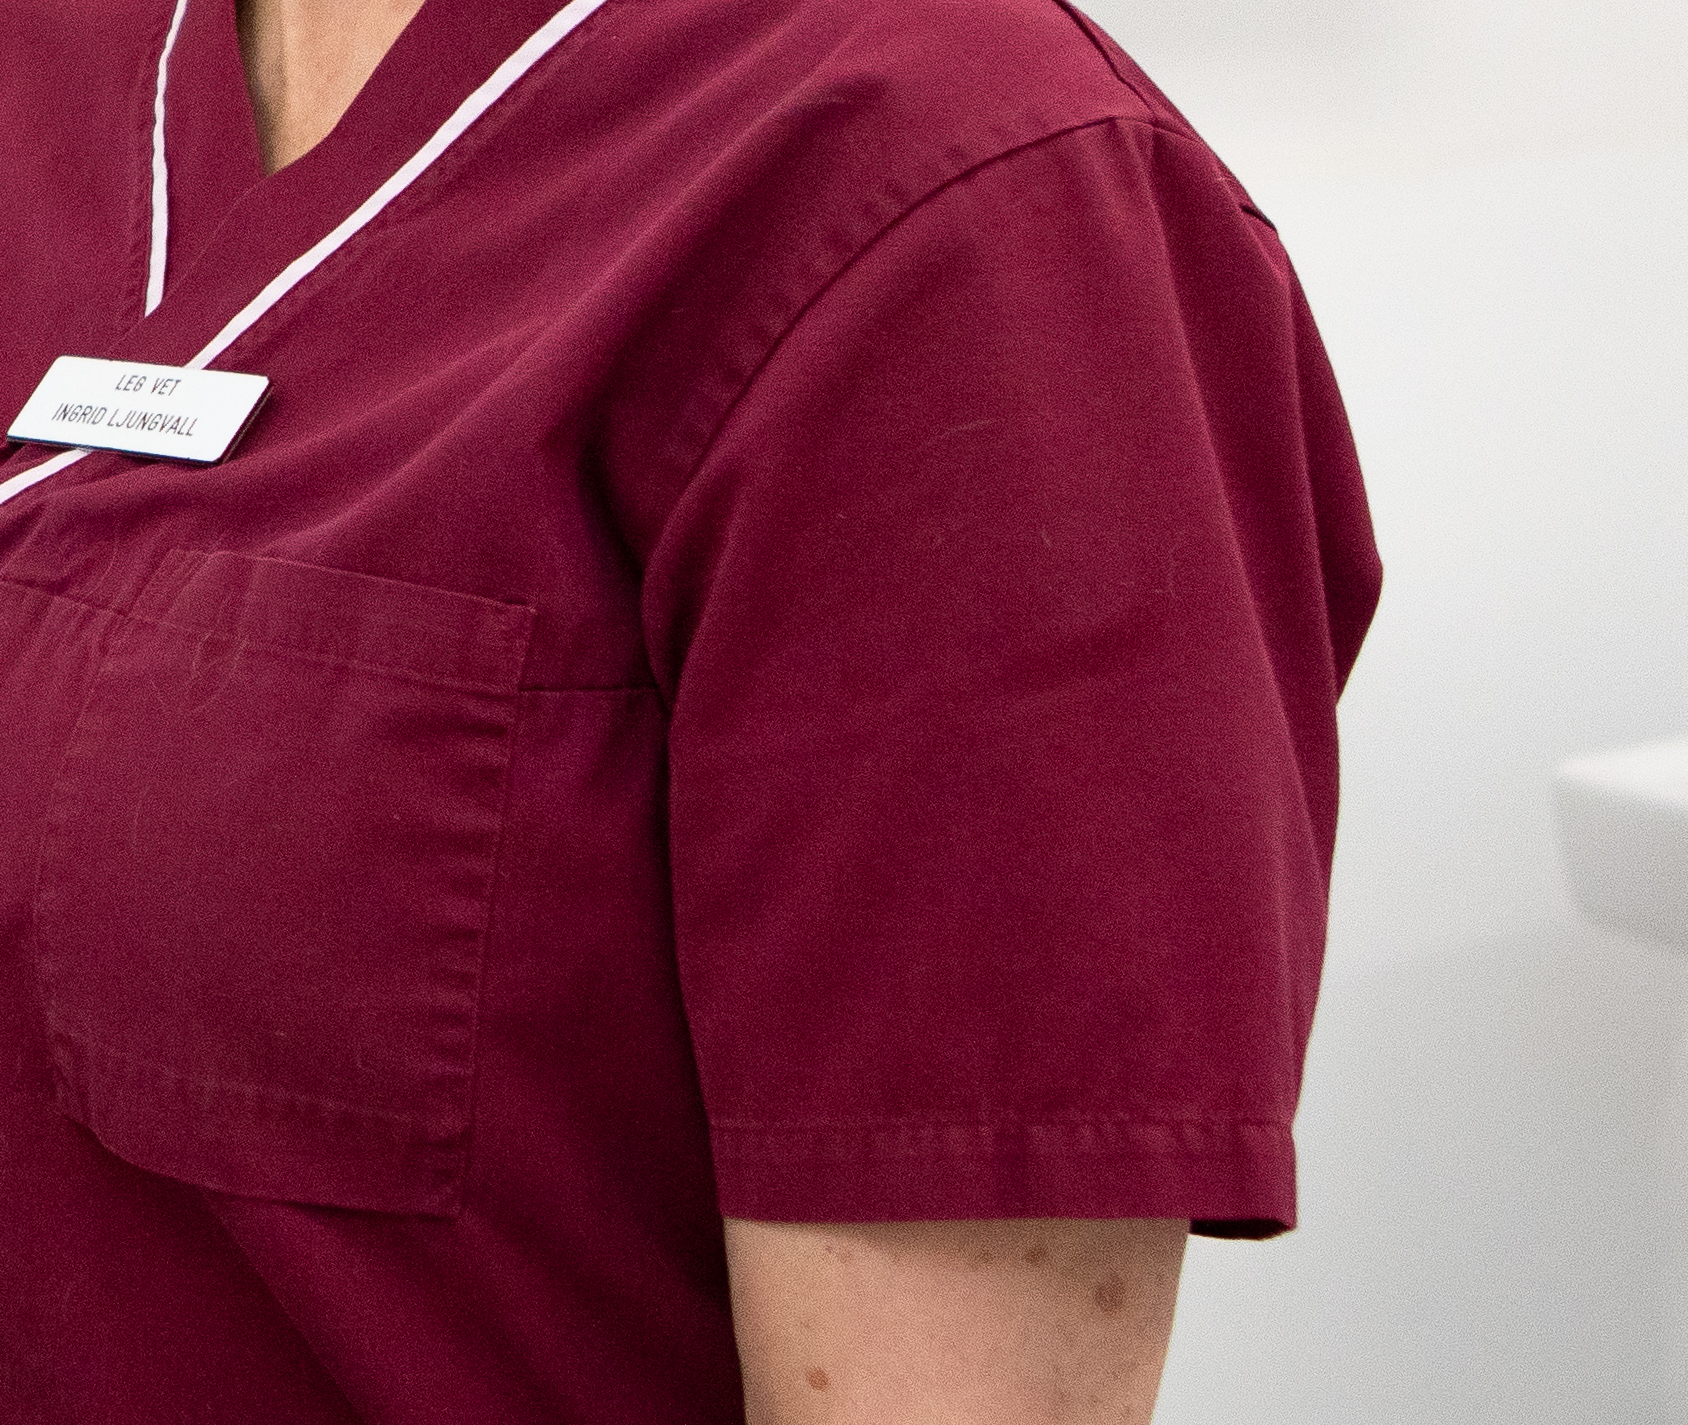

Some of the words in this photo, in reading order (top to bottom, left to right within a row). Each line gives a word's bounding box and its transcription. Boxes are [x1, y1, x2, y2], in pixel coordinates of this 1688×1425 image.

[114, 374, 147, 393] LEG
[151, 378, 182, 397] VET
[51, 402, 107, 427] INGRID
[107, 409, 199, 437] LJUNGVALL
